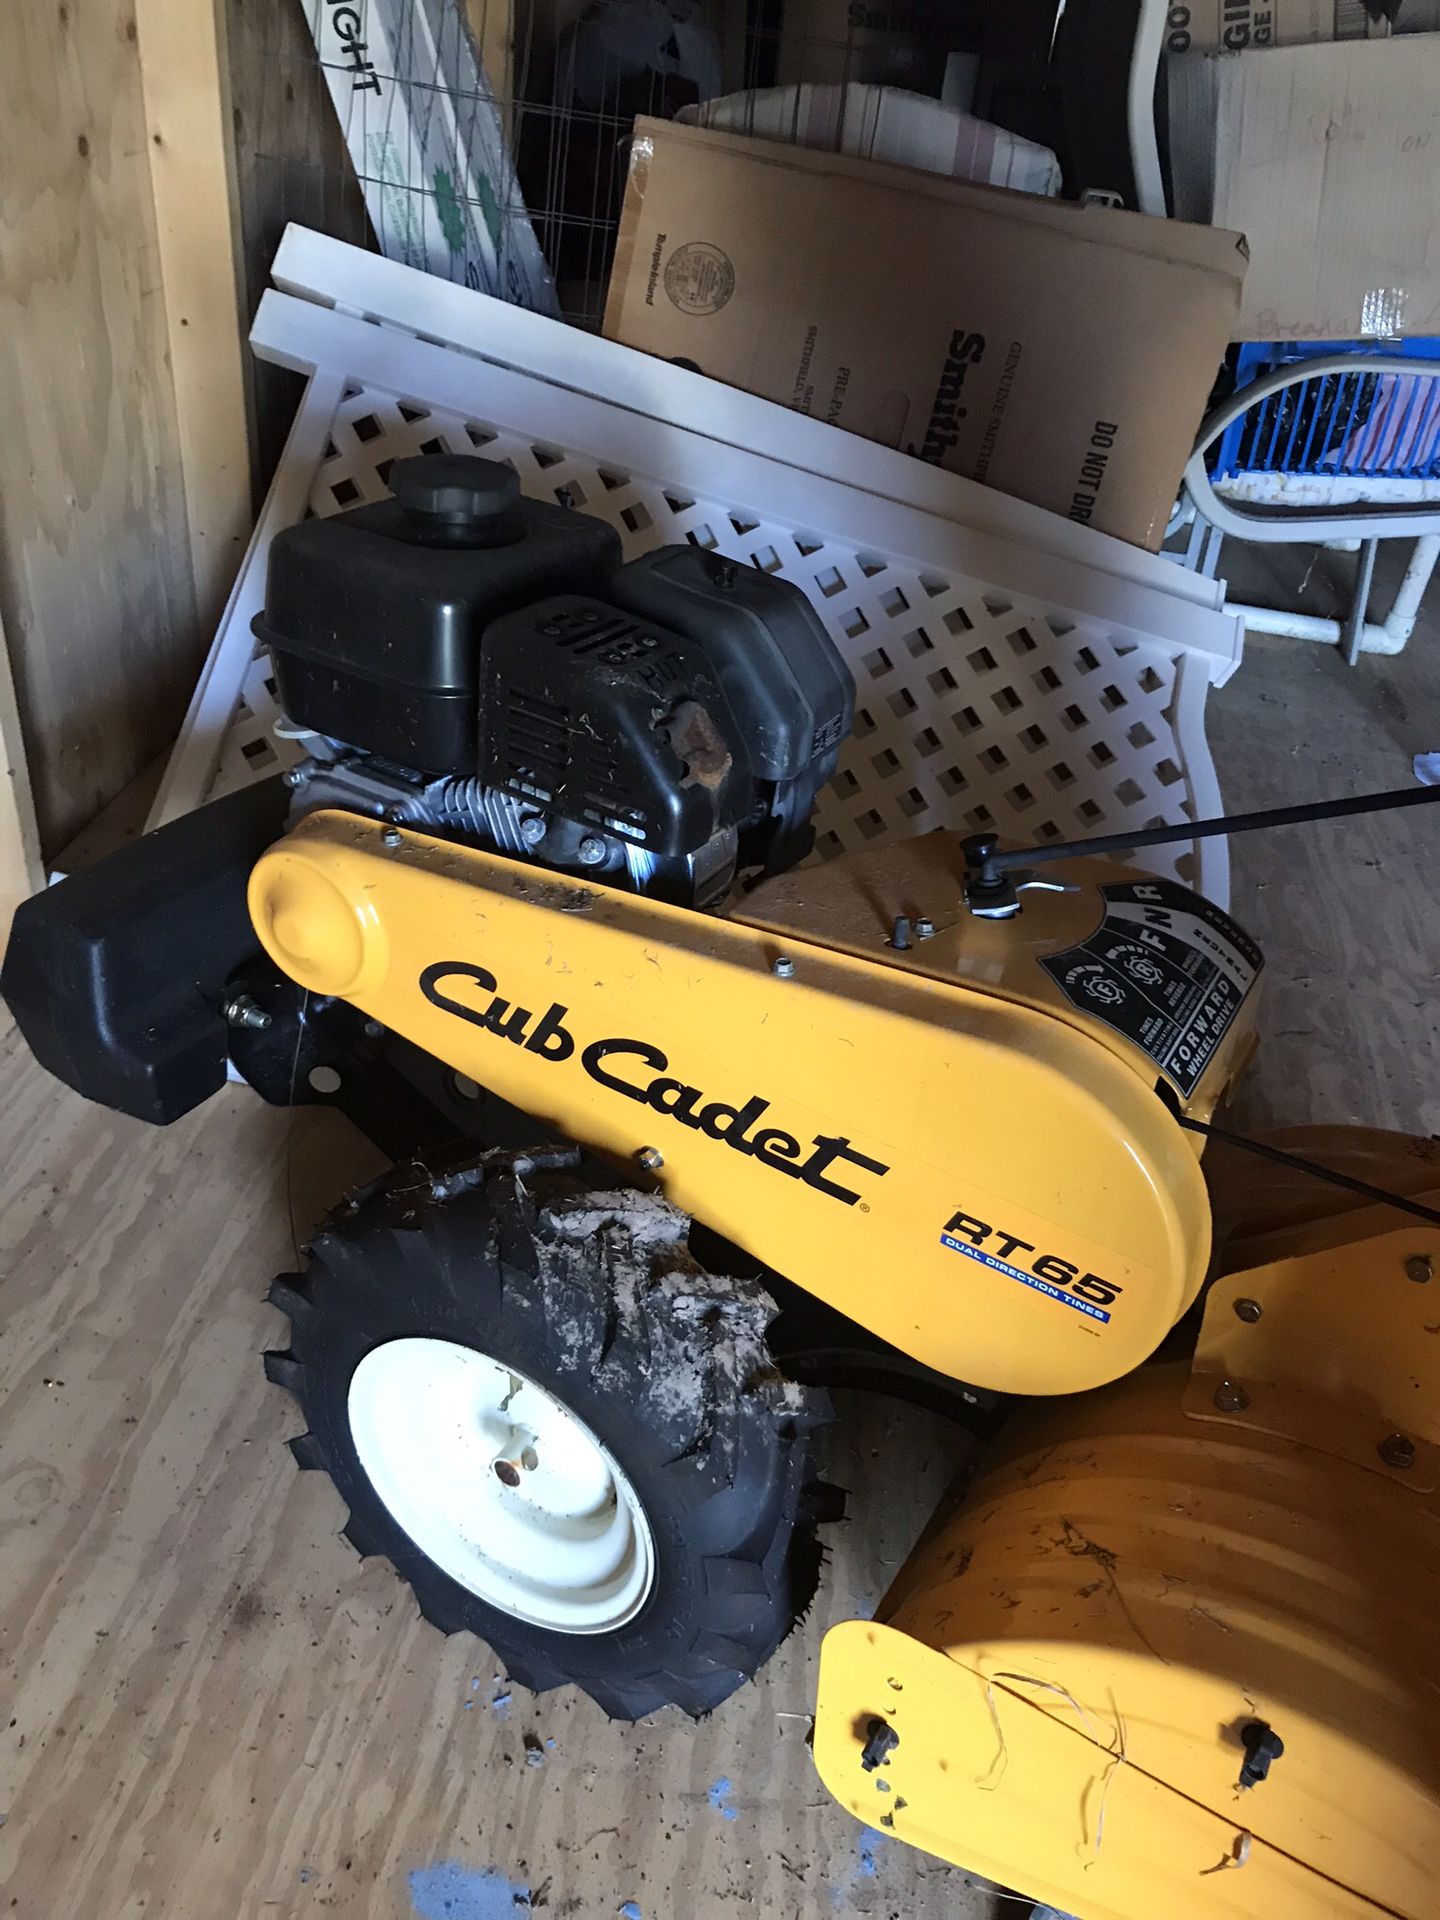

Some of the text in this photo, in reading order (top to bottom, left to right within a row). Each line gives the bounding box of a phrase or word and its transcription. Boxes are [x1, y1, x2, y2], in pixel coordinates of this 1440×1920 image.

[908, 329, 986, 465] Smith
[973, 341, 1023, 484] GENUINE SMITHFI
[1068, 420, 1120, 525] DO NOT DR
[1132, 885, 1162, 900] R
[1144, 907, 1172, 928] N
[1139, 930, 1168, 952] F
[1193, 929, 1247, 982] NEUTRAL
[1139, 1016, 1153, 1033] TINES
[1143, 1018, 1163, 1044] FORWARD
[1172, 979, 1229, 1075] FORWARD
[1187, 999, 1235, 1077] WHEEL DRIVE
[419, 961, 891, 1207] Cub Cadet
[945, 1237, 1104, 1319] DUAL DIRECTION TINES
